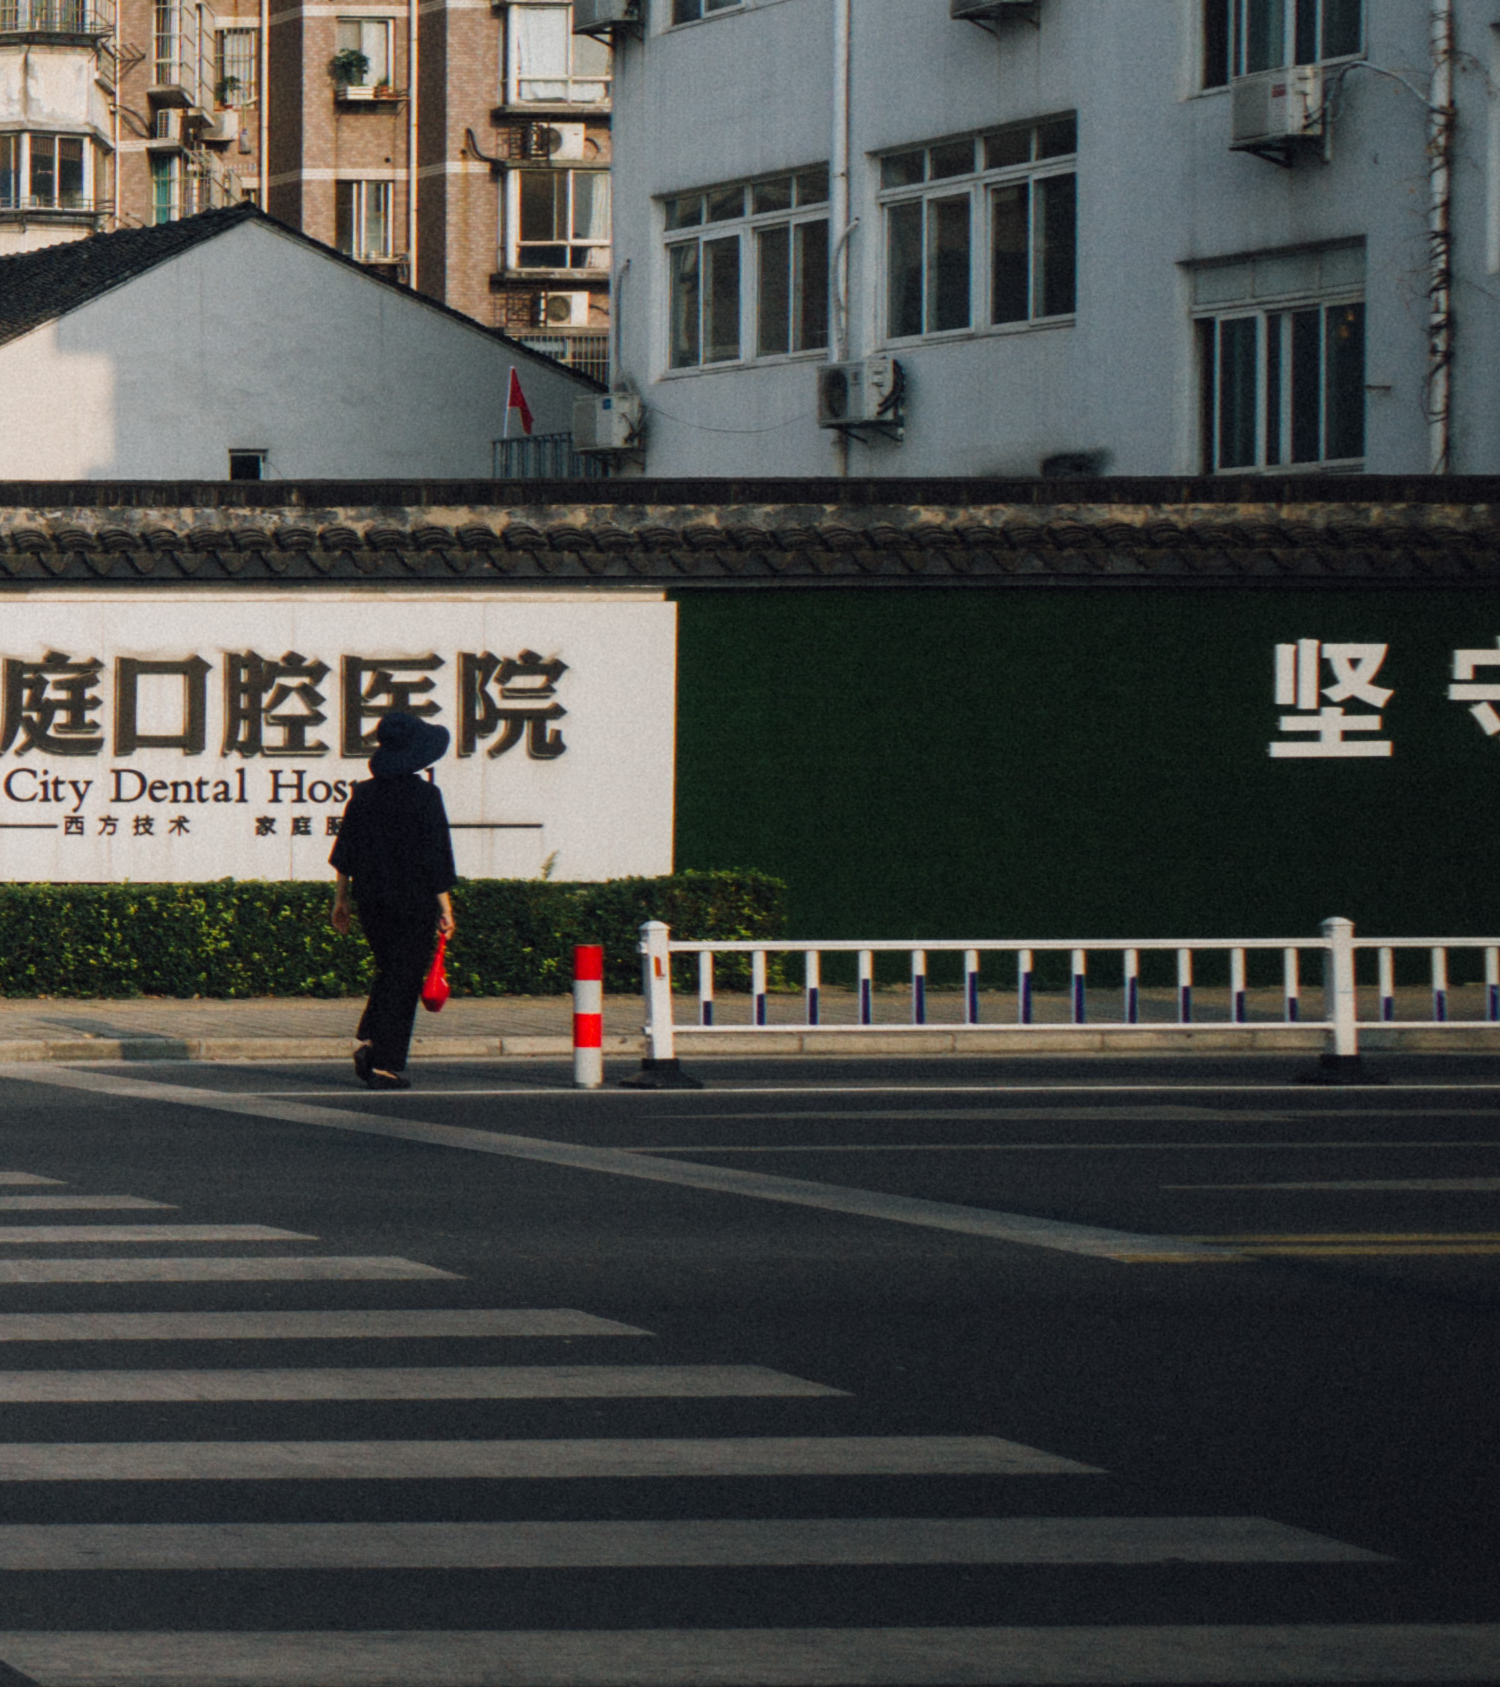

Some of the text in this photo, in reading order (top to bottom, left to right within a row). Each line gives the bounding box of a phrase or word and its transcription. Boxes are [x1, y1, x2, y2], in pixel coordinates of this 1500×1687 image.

[3, 768, 93, 812] City
[110, 767, 248, 803] Dental
[64, 815, 190, 836] 西方技术
